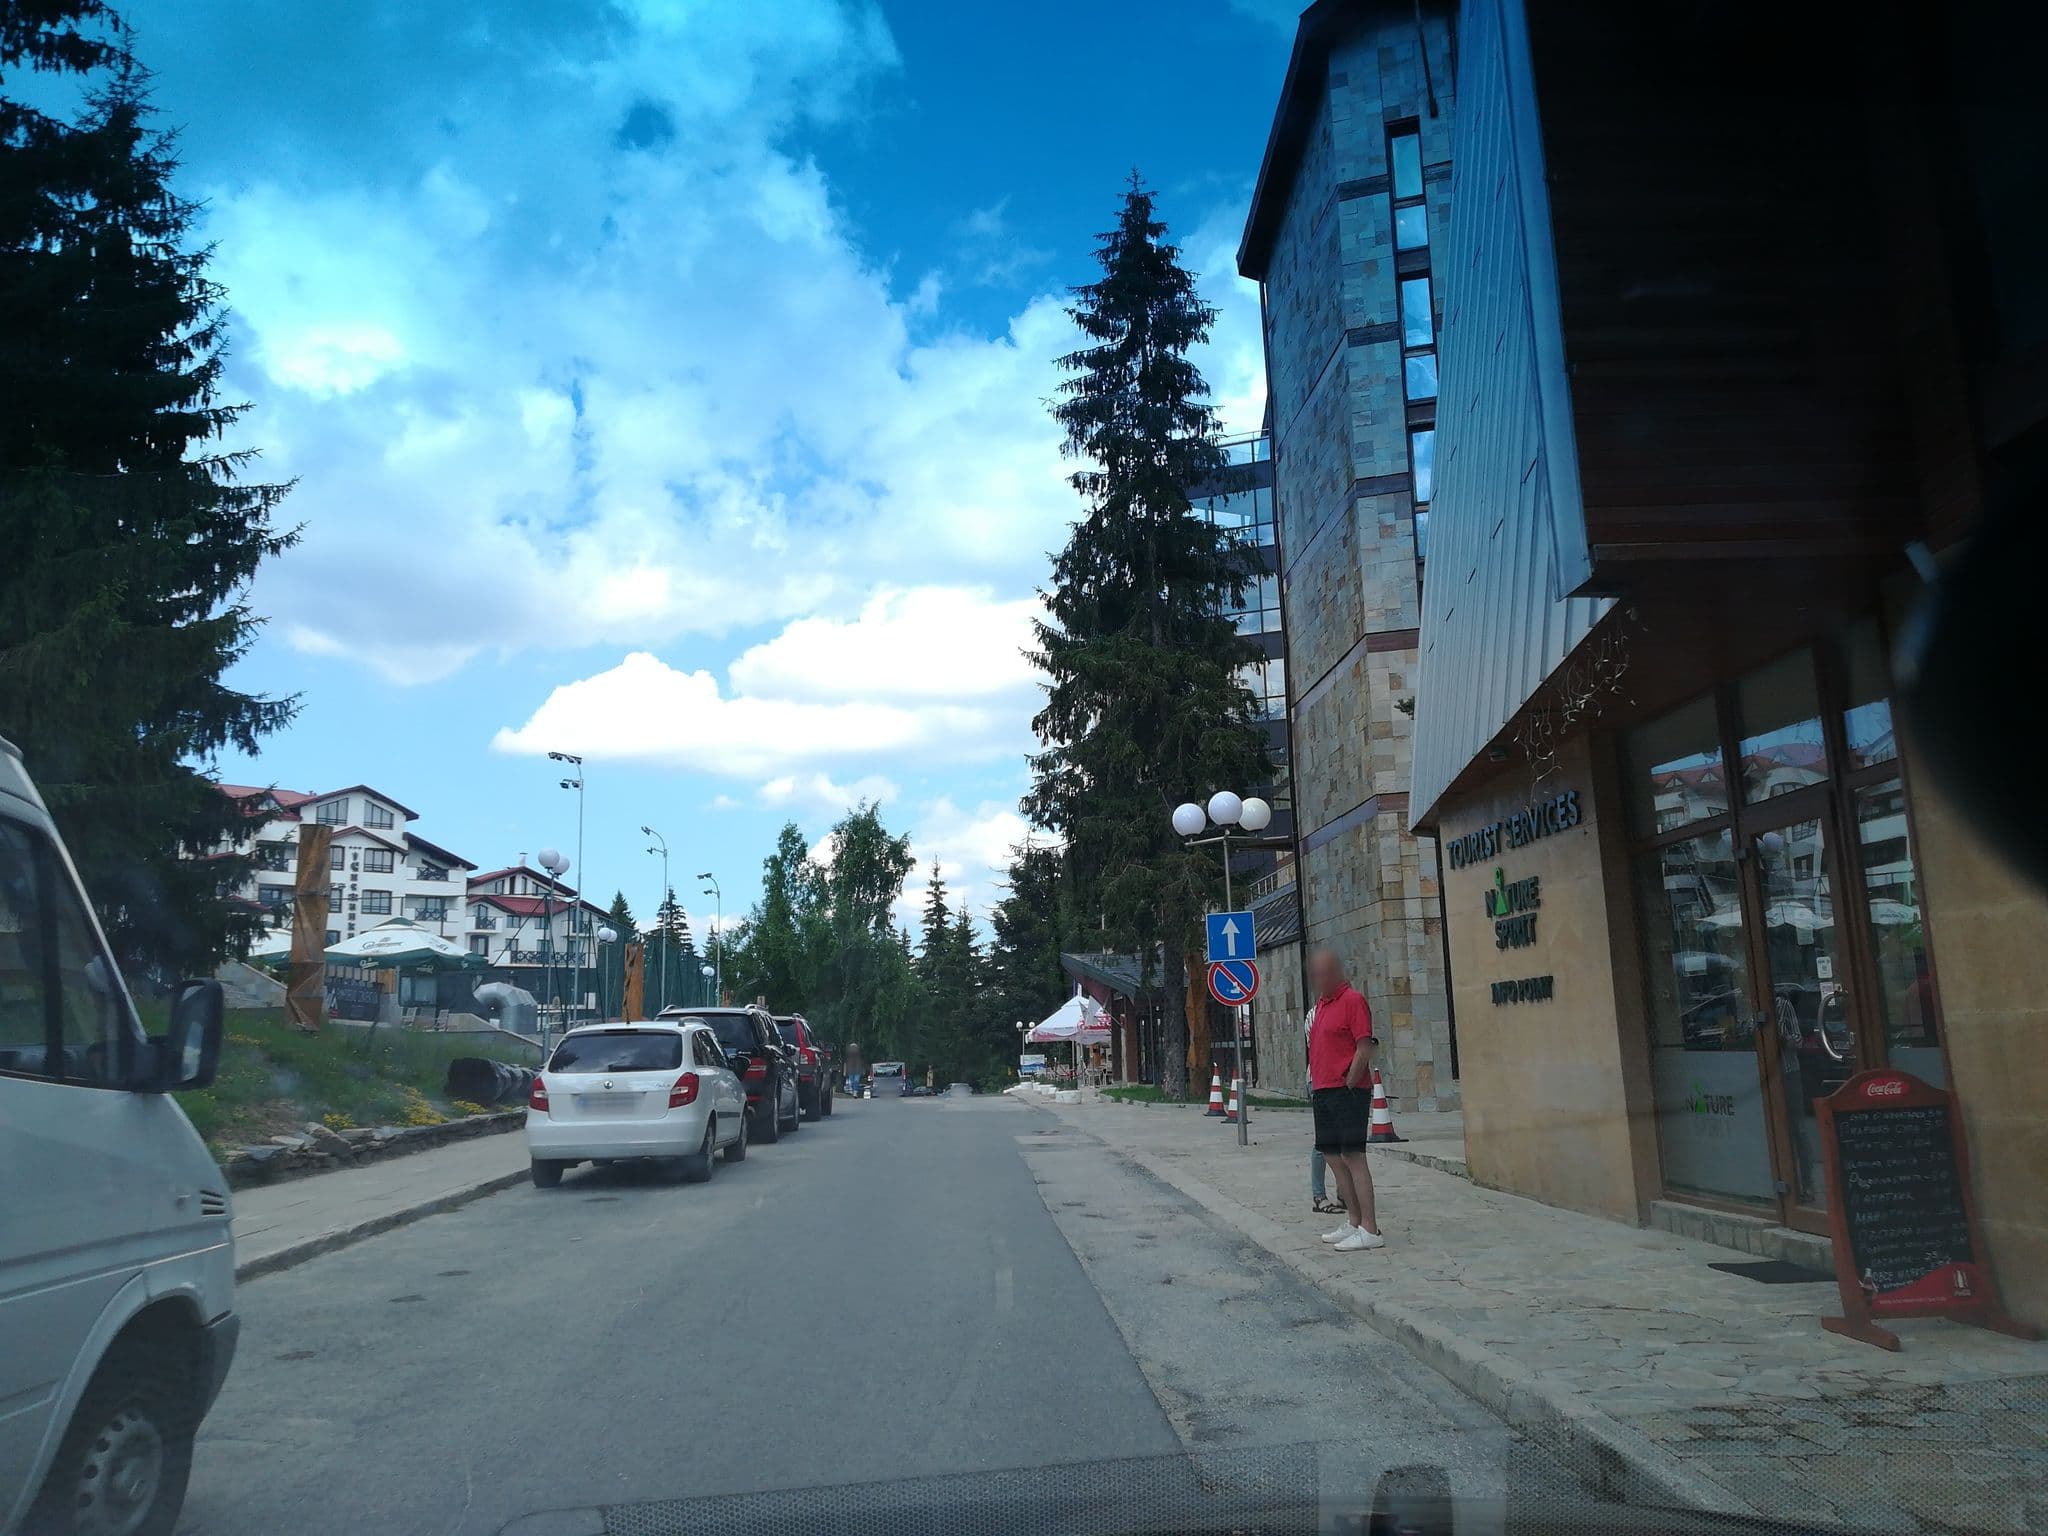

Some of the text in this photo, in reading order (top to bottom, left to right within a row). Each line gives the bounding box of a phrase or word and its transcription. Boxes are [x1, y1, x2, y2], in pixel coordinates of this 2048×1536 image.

[1447, 790, 1582, 869] TOURIST SERVICES
[1495, 912, 1538, 950] SPIRIT
[1867, 1081, 1904, 1097] Coca-Cola
